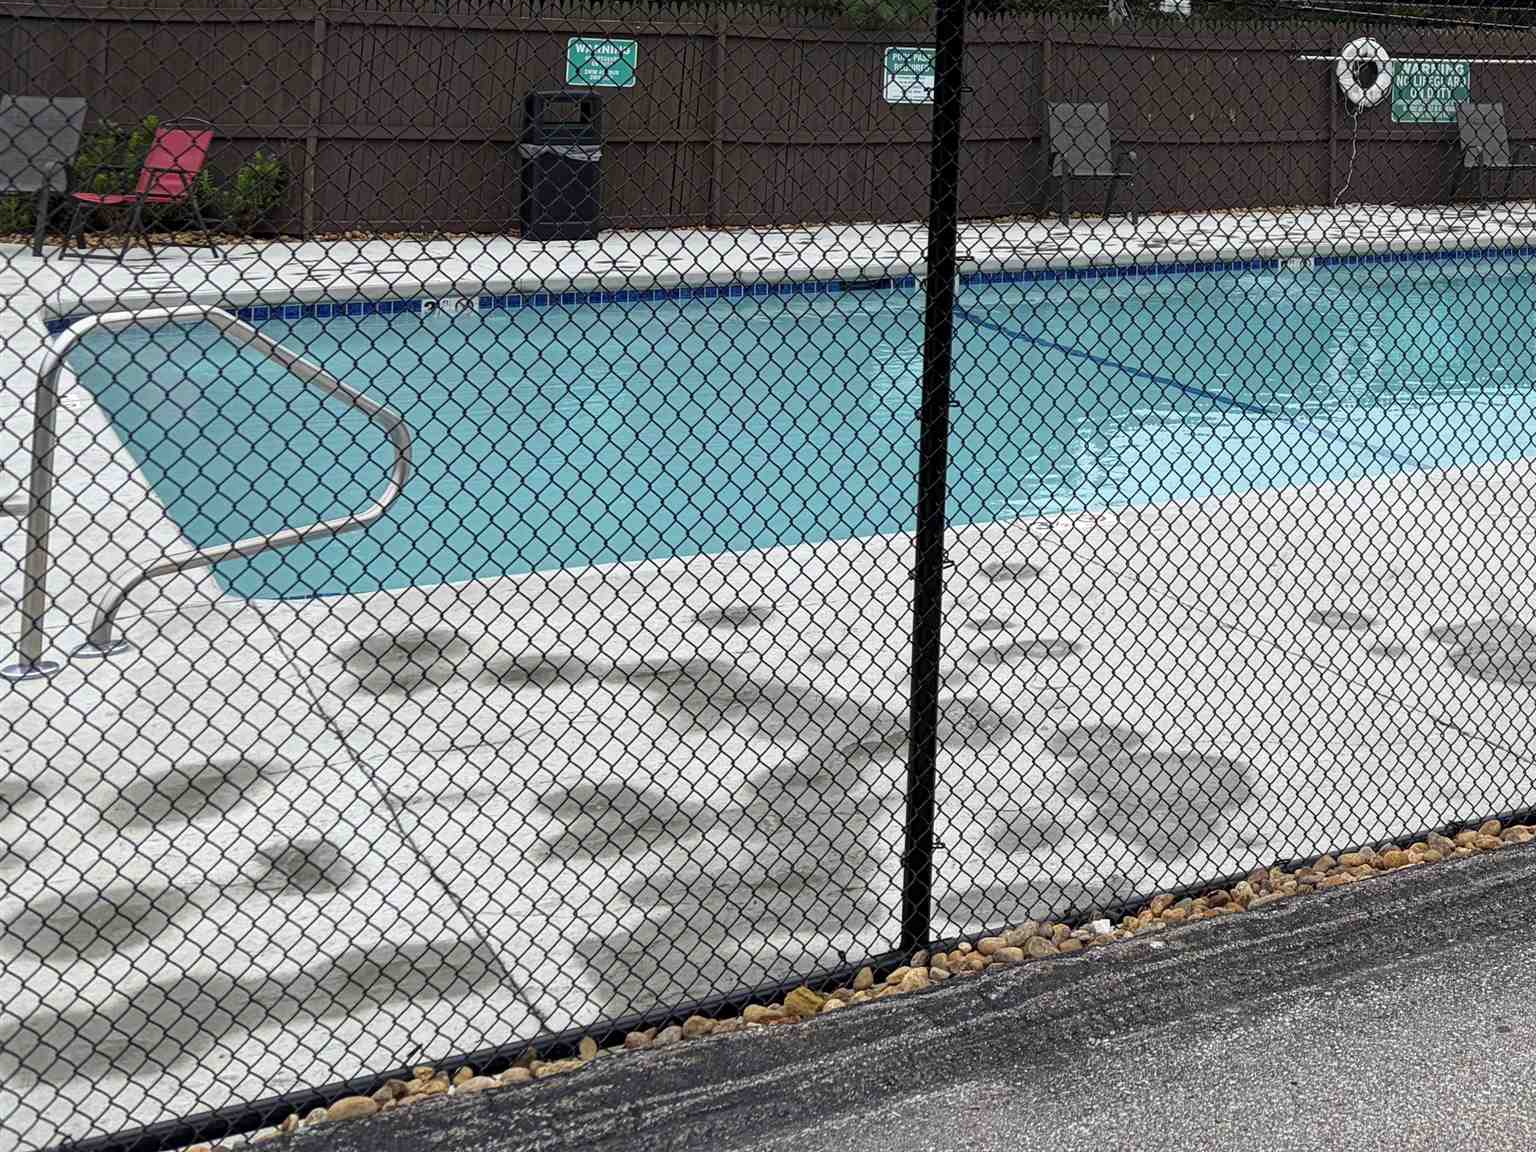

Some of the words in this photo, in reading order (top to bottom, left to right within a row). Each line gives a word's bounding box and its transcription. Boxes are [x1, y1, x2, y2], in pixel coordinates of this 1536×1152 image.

[575, 43, 631, 55] WARNING
[1402, 62, 1464, 76] WARNING
[1396, 75, 1410, 87] NO
